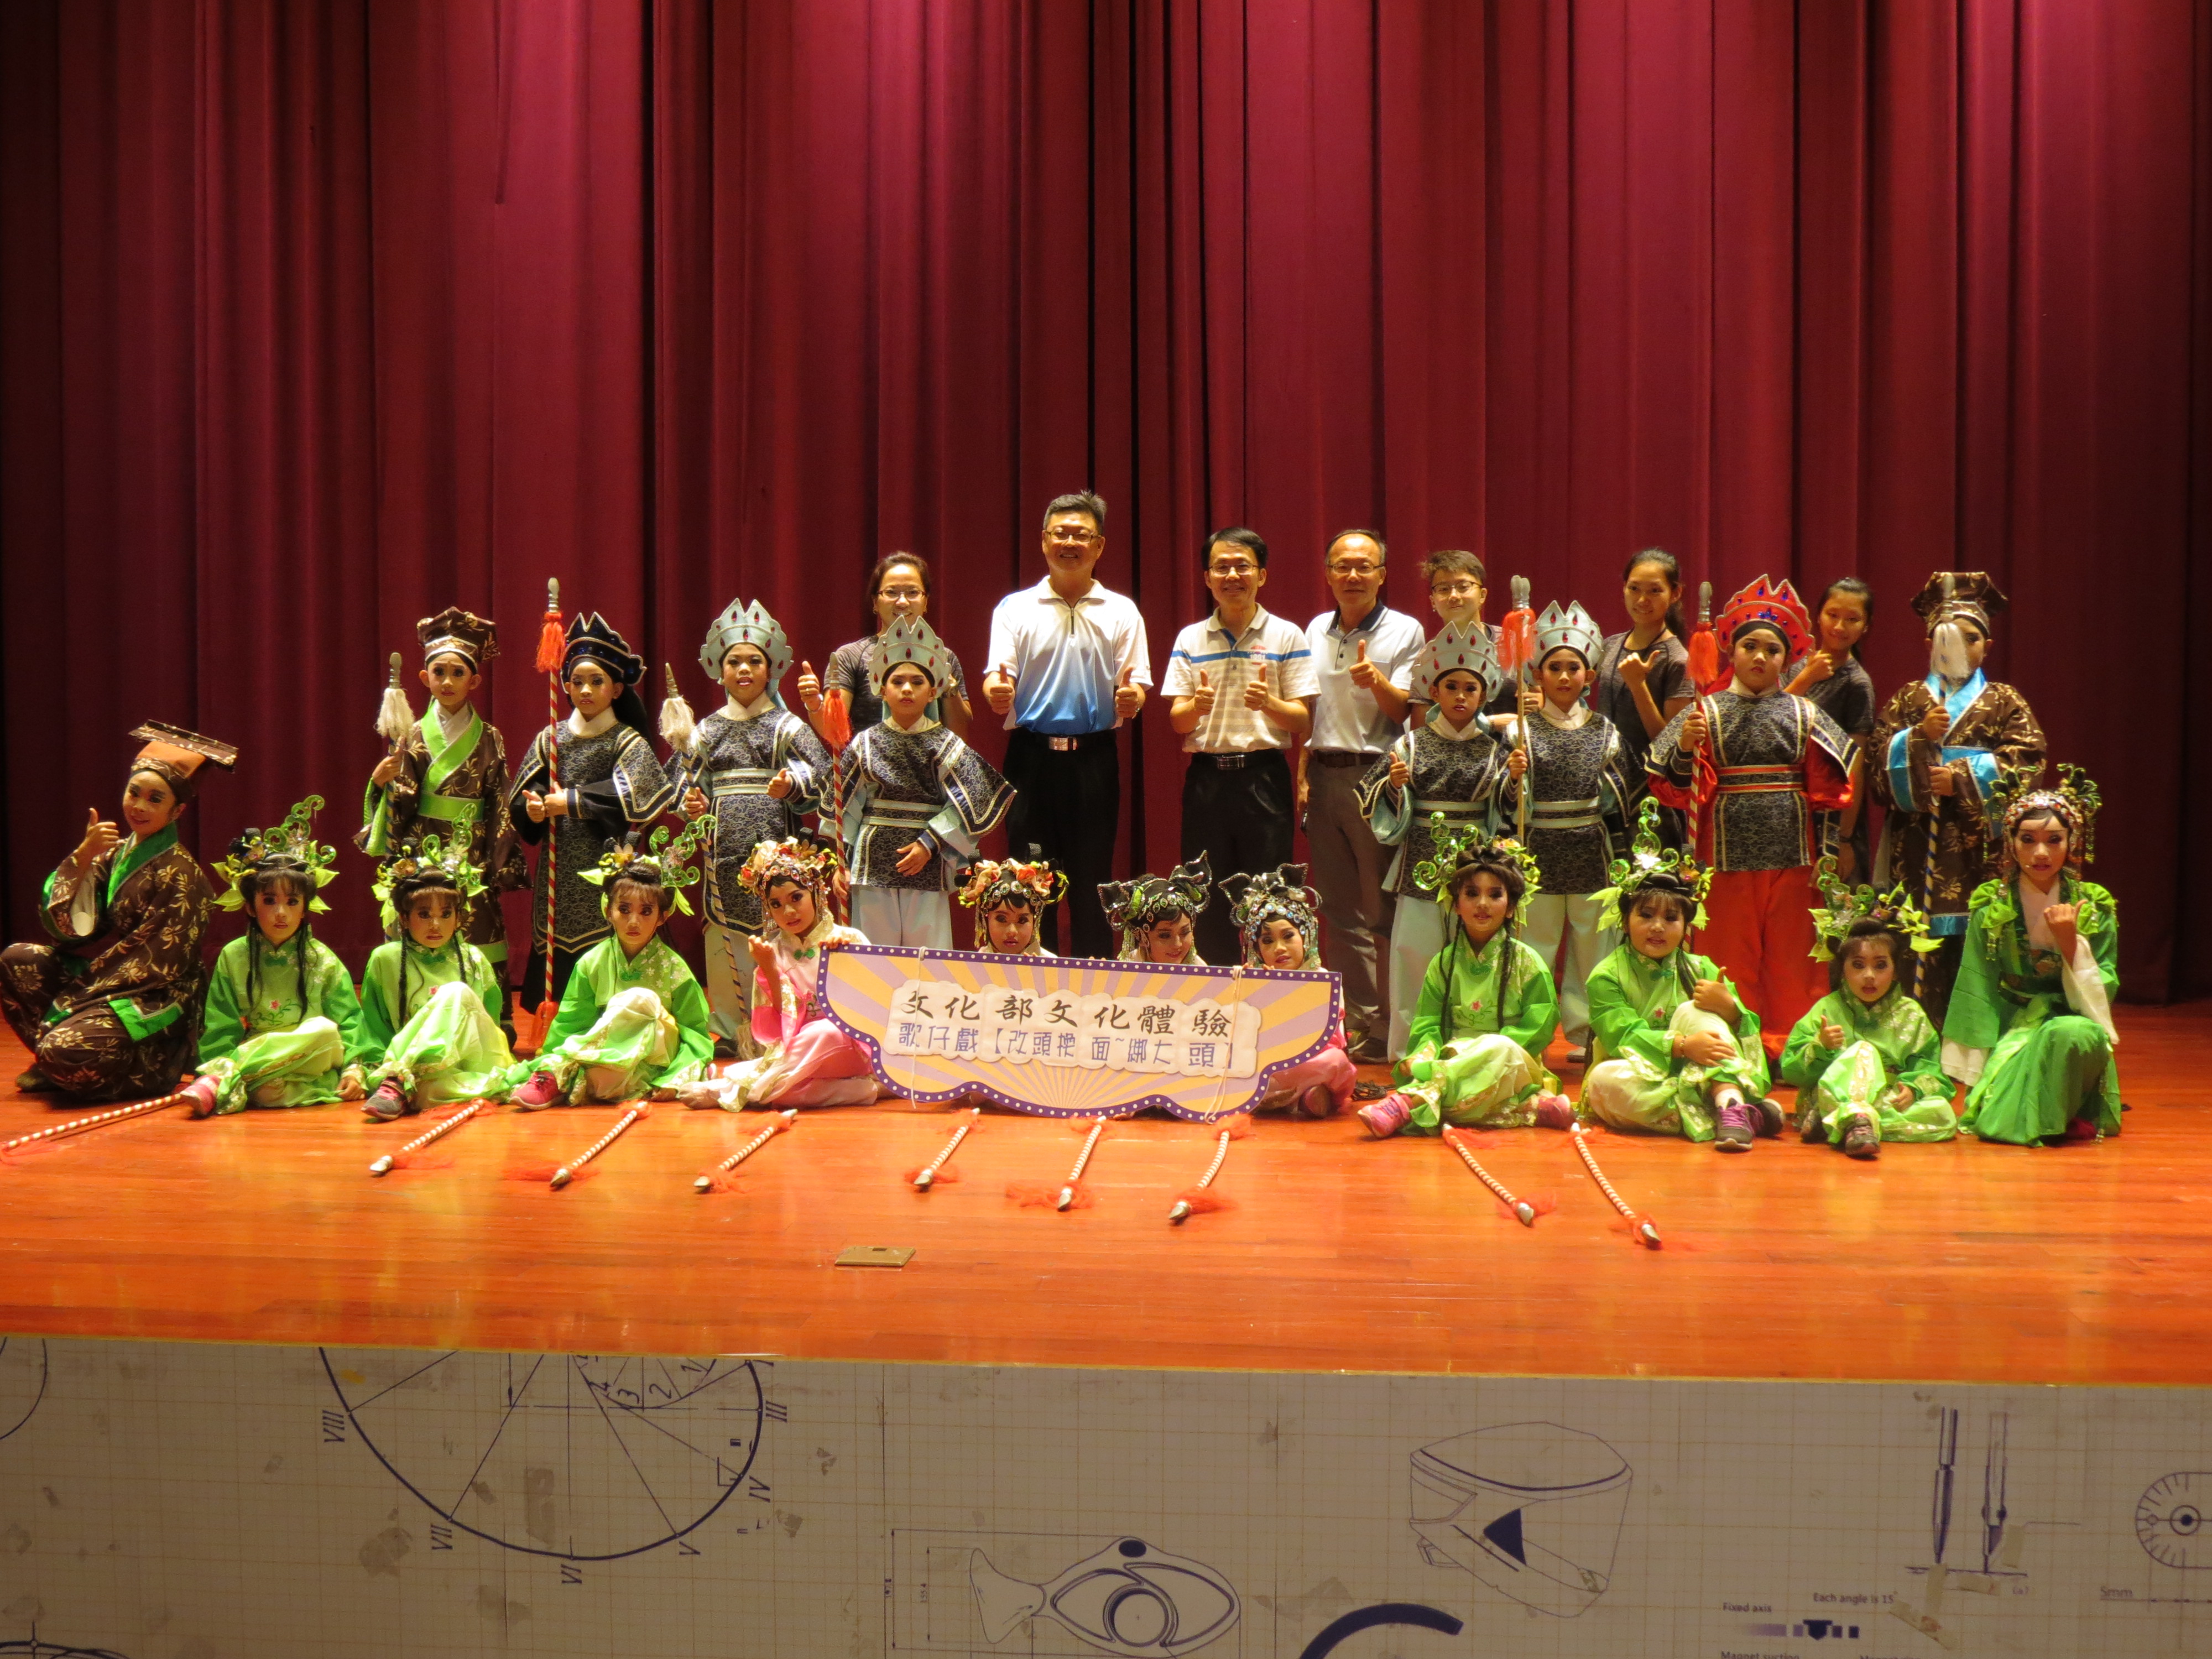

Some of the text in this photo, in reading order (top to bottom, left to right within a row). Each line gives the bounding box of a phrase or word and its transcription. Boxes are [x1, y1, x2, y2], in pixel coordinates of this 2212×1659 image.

[900, 990, 1233, 1038] 文化部文化體驗
[618, 1388, 640, 1405] 3
[648, 1383, 672, 1400] 2
[679, 1541, 701, 1557] V
[1813, 1592, 1837, 1603] Each
[1839, 1593, 1868, 1605] angle
[1722, 1602, 1772, 1613] Fixed axis
